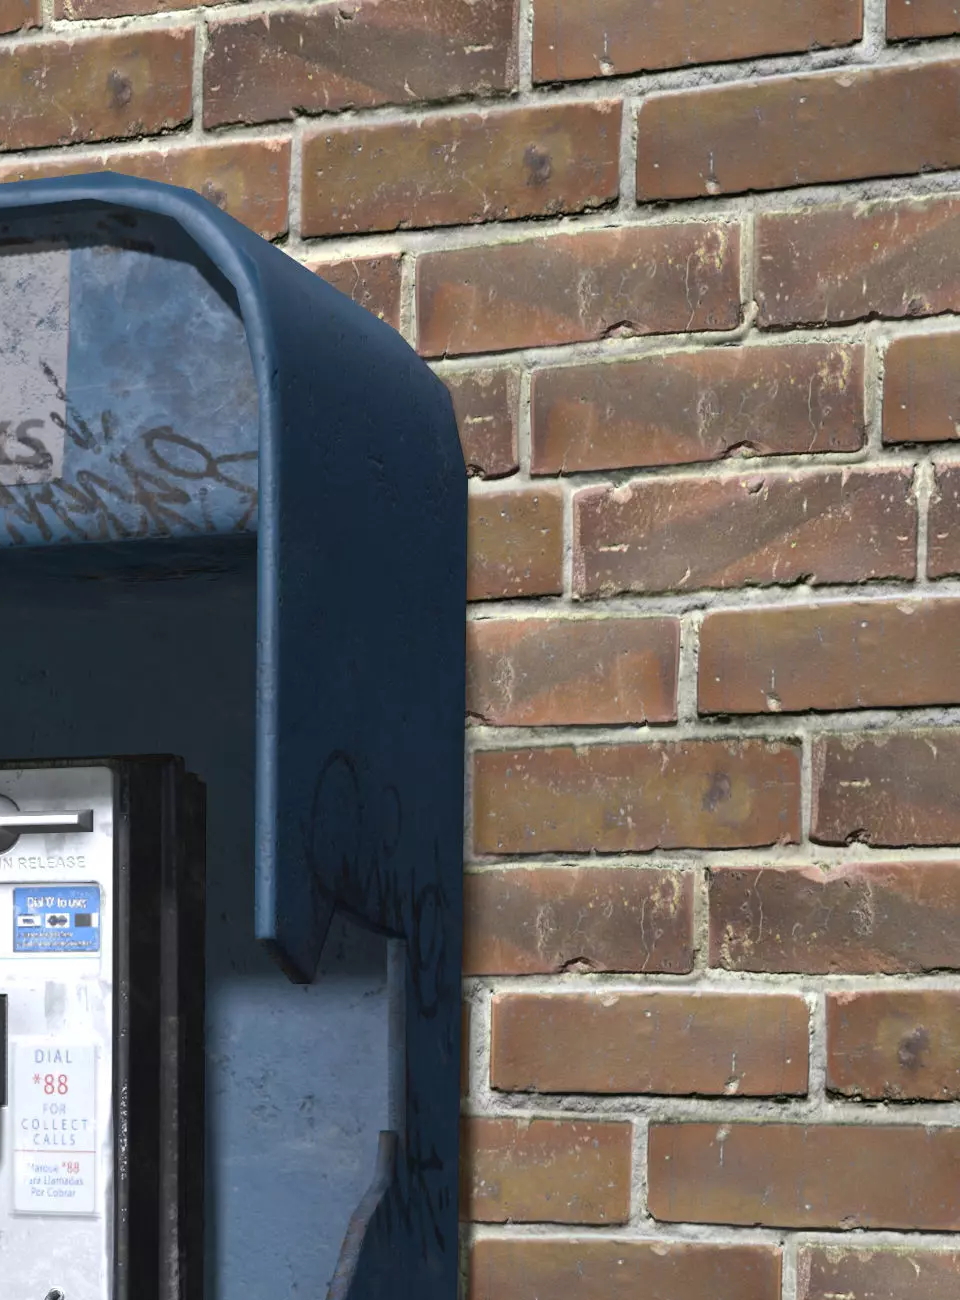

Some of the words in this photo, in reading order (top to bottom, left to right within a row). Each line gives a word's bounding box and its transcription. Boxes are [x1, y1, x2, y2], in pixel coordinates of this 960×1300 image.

[17, 856, 86, 870] RELEASE
[34, 1049, 73, 1064] DIAL
[42, 1103, 66, 1115] FOR
[21, 1118, 88, 1131] COLLECT
[33, 1133, 76, 1146] CALLS
